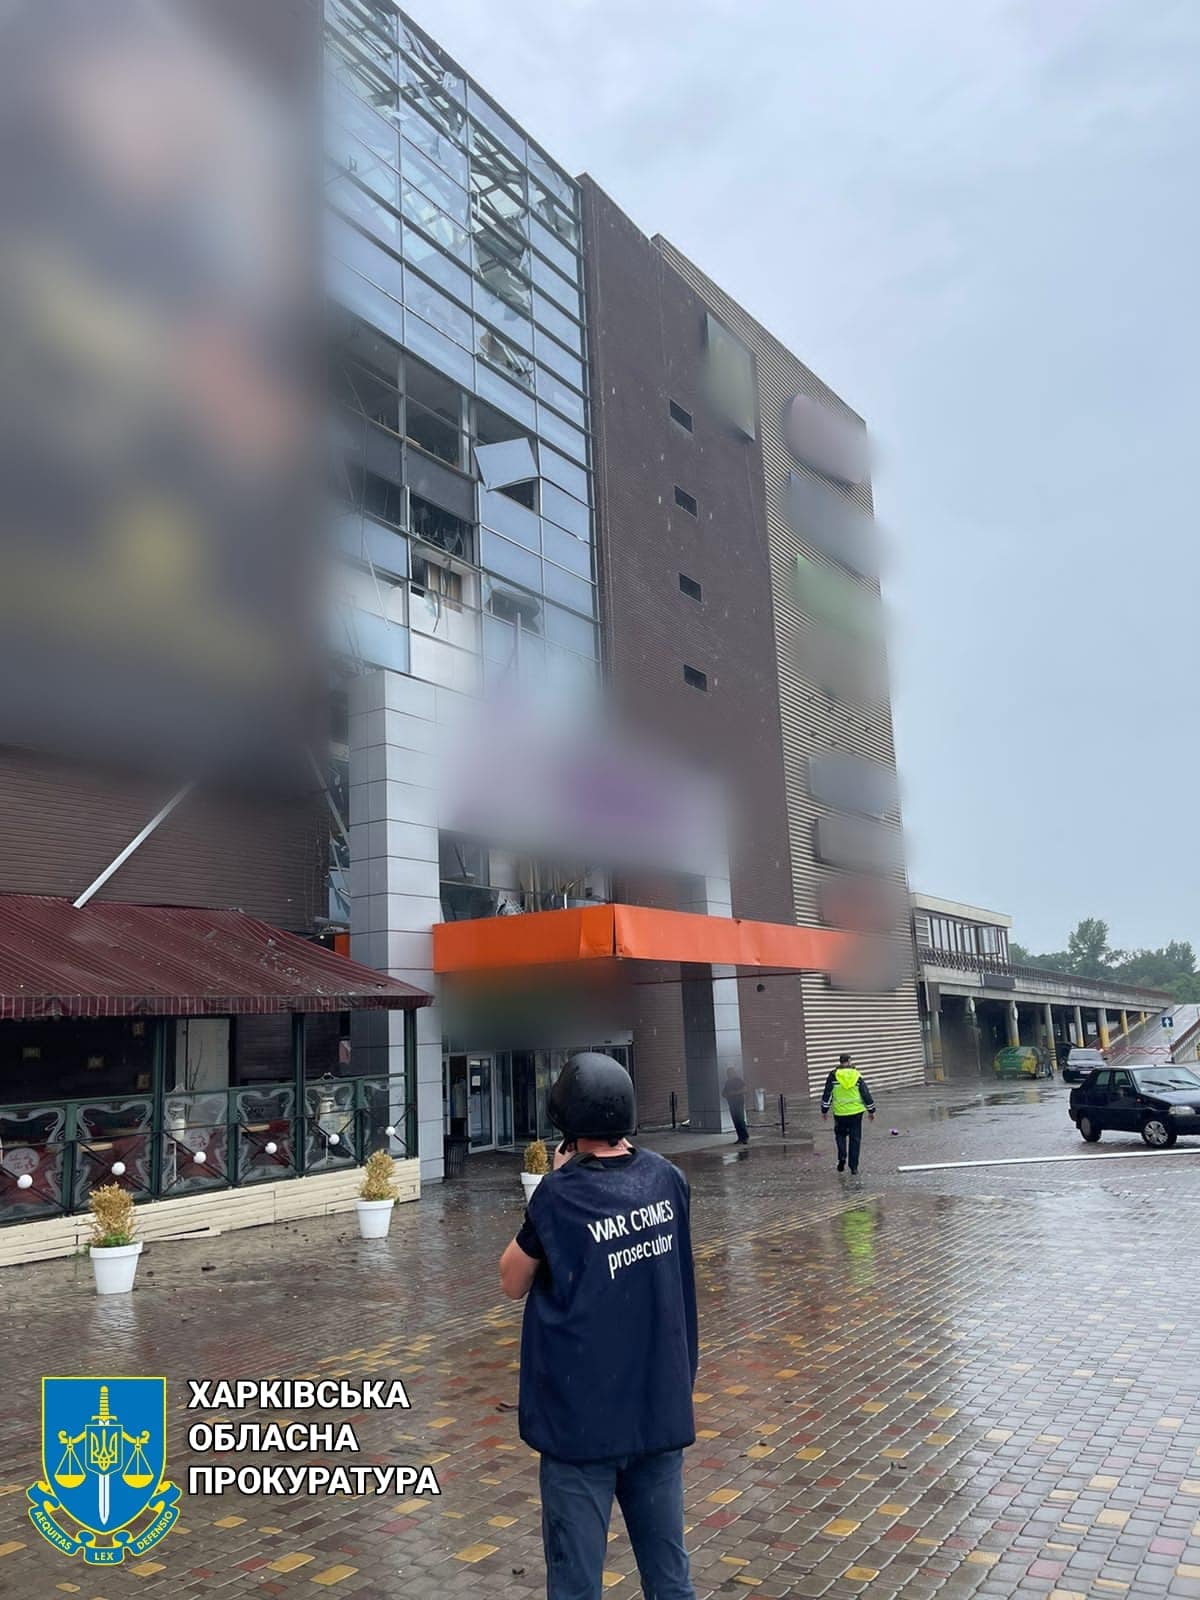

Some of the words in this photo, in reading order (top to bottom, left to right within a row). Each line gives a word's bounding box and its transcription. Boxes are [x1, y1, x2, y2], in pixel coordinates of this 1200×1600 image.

[587, 1215, 630, 1243] WAR
[630, 1200, 674, 1231] CRIMES
[608, 1234, 673, 1280] prosecutor
